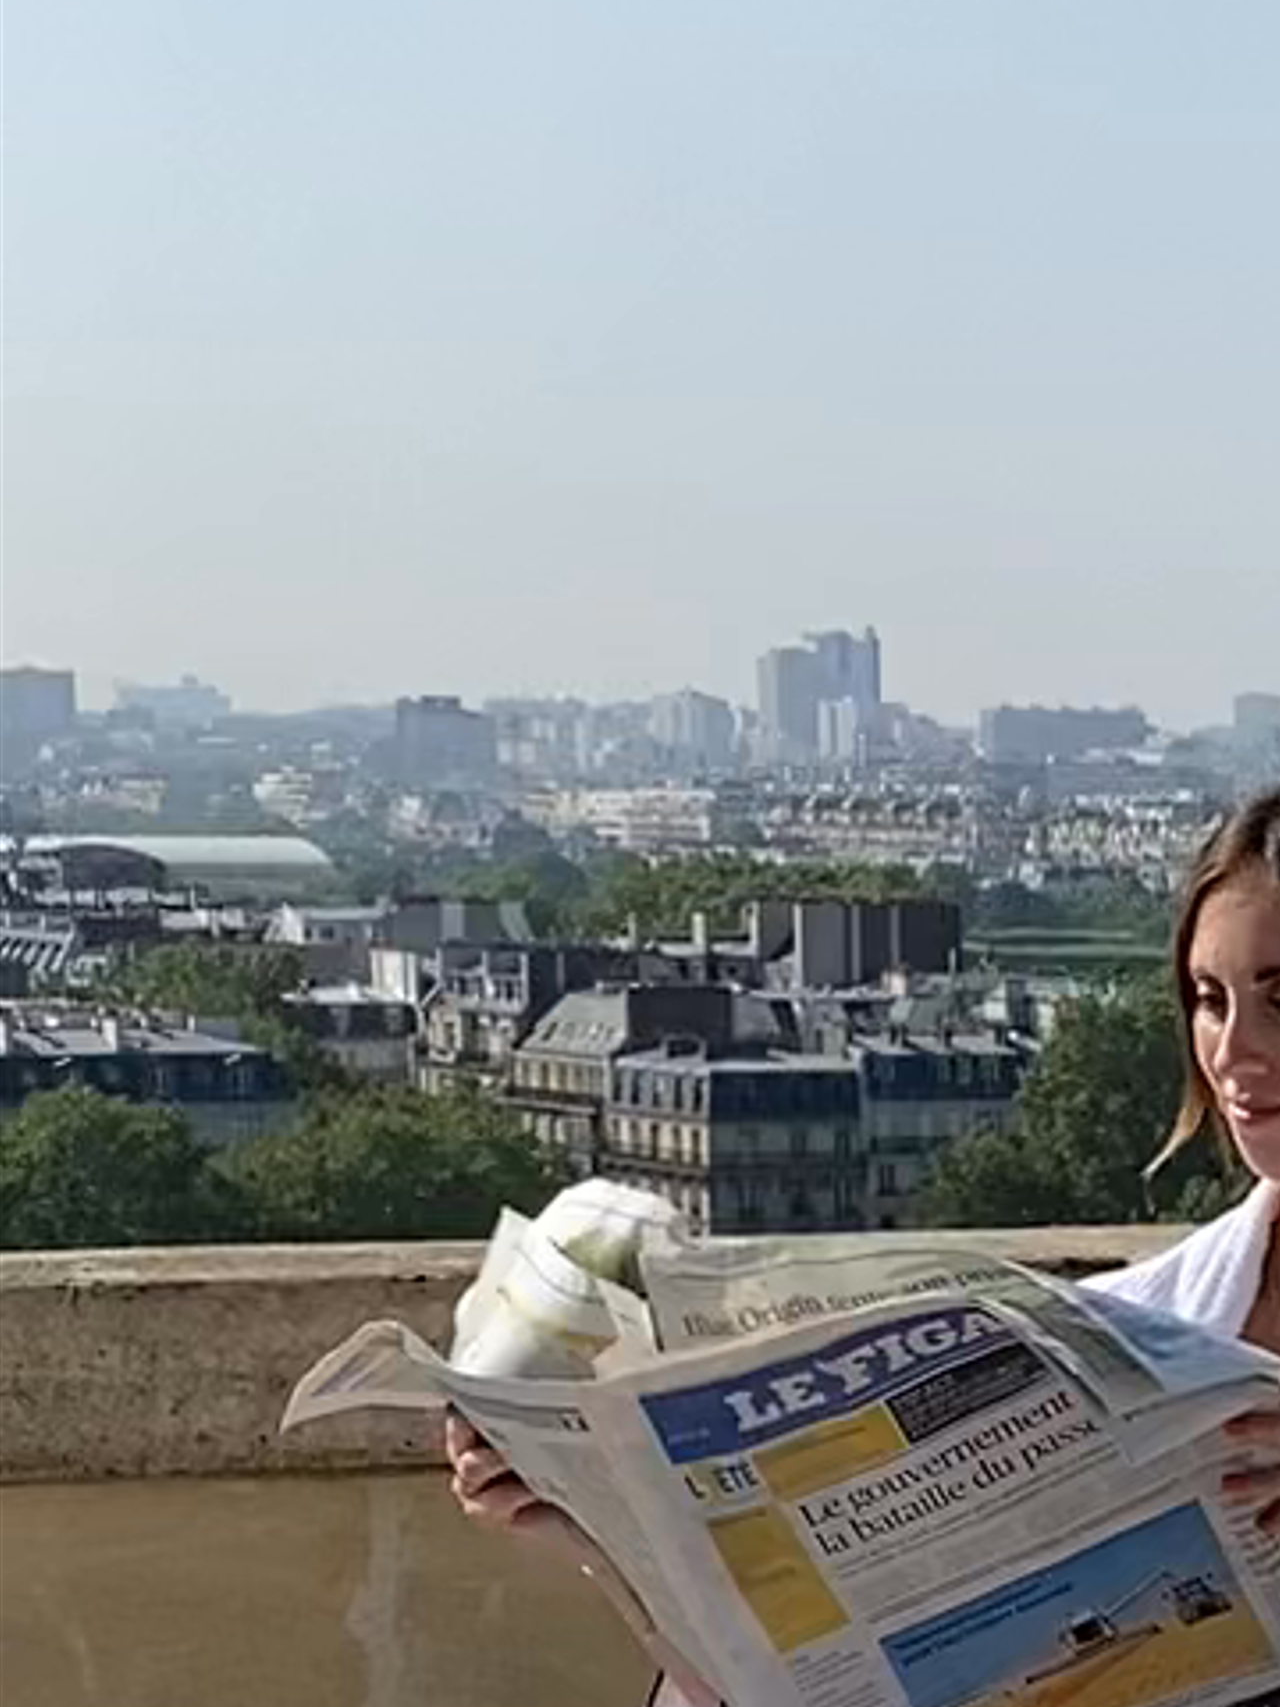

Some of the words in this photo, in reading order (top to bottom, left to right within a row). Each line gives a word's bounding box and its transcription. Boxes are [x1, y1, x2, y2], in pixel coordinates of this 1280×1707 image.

[724, 1371, 827, 1433] LE
[799, 1493, 846, 1529] Le
[848, 1390, 1077, 1511] gouvernement
[815, 1523, 853, 1558] la
[847, 1475, 967, 1545] bataille
[971, 1449, 1021, 1493] du
